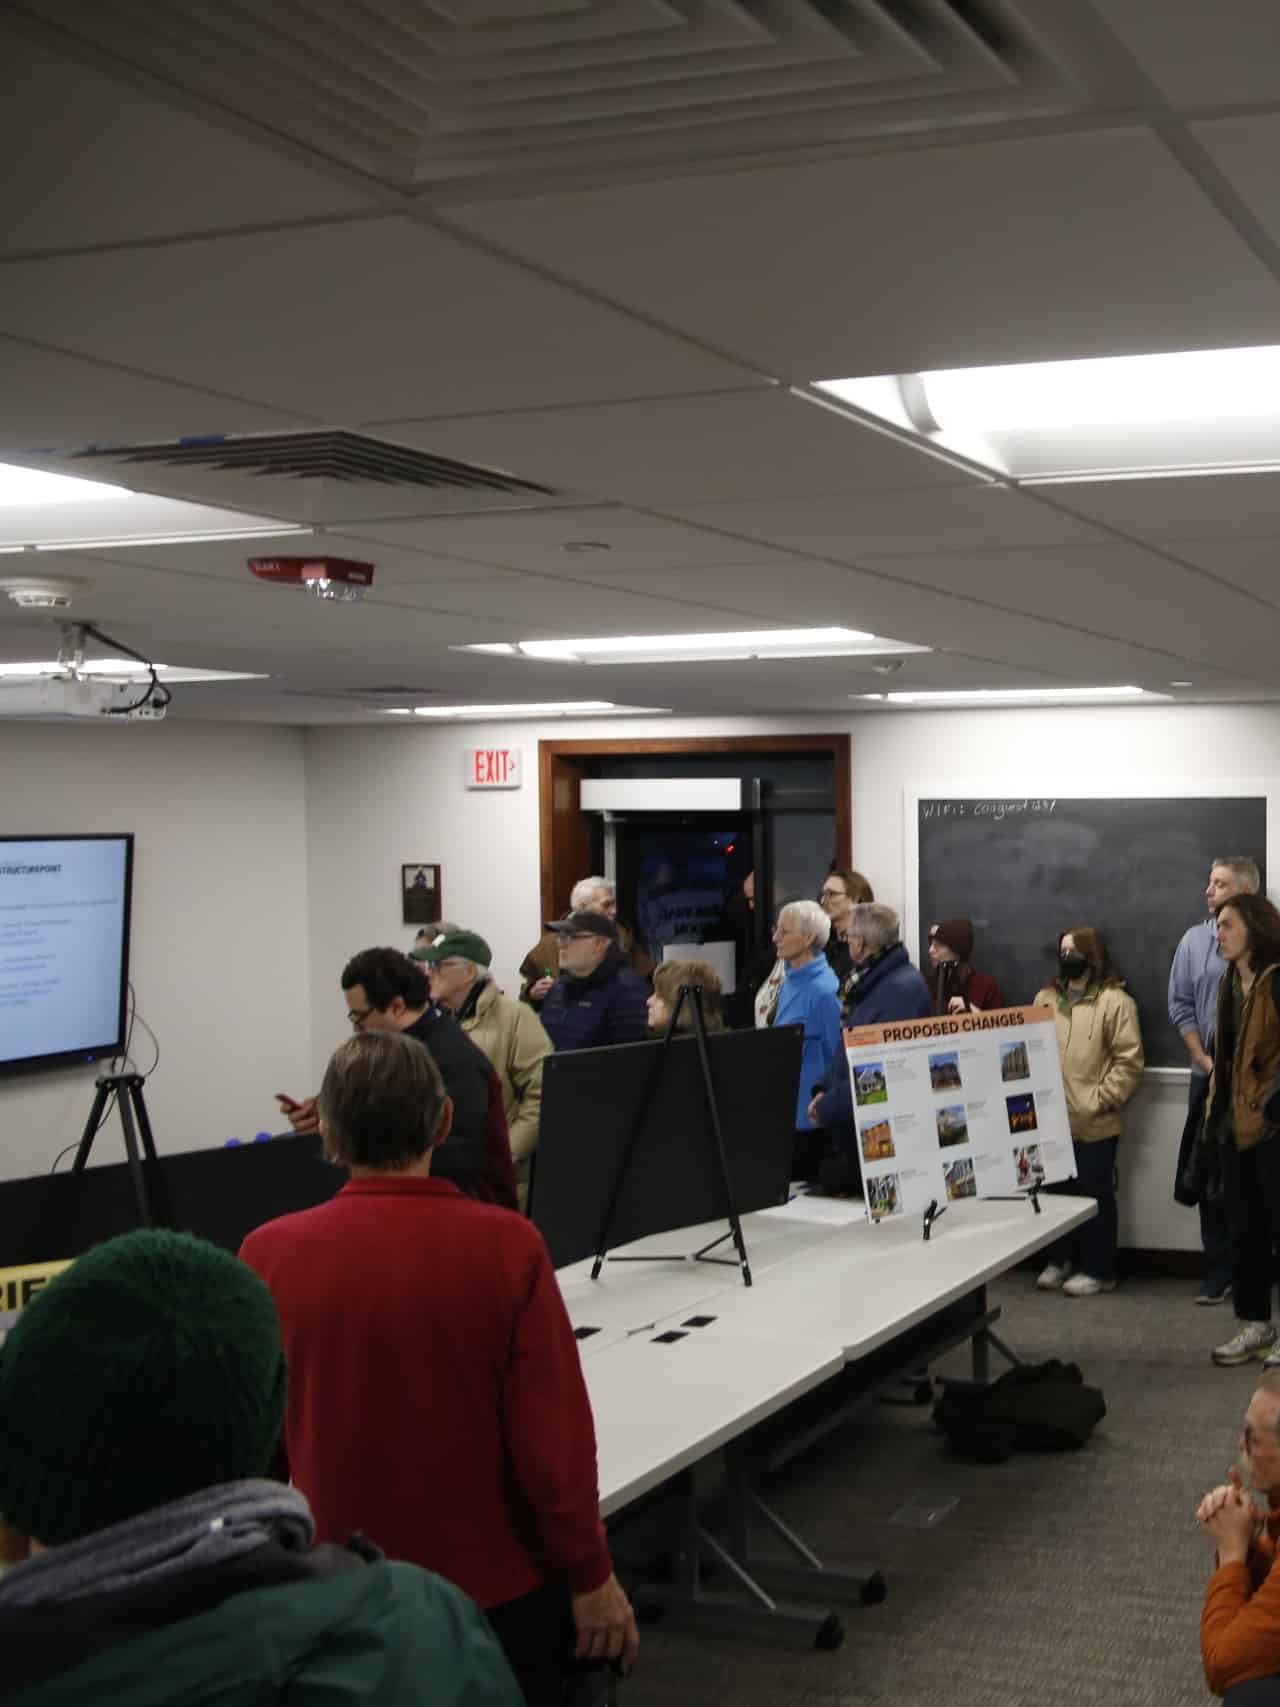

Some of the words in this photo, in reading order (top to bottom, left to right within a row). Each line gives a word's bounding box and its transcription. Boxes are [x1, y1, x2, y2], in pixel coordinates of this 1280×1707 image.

[474, 750, 509, 783] EXIT
[882, 1021, 959, 1043] PROPOSED
[962, 1012, 1025, 1034] CHANGES
